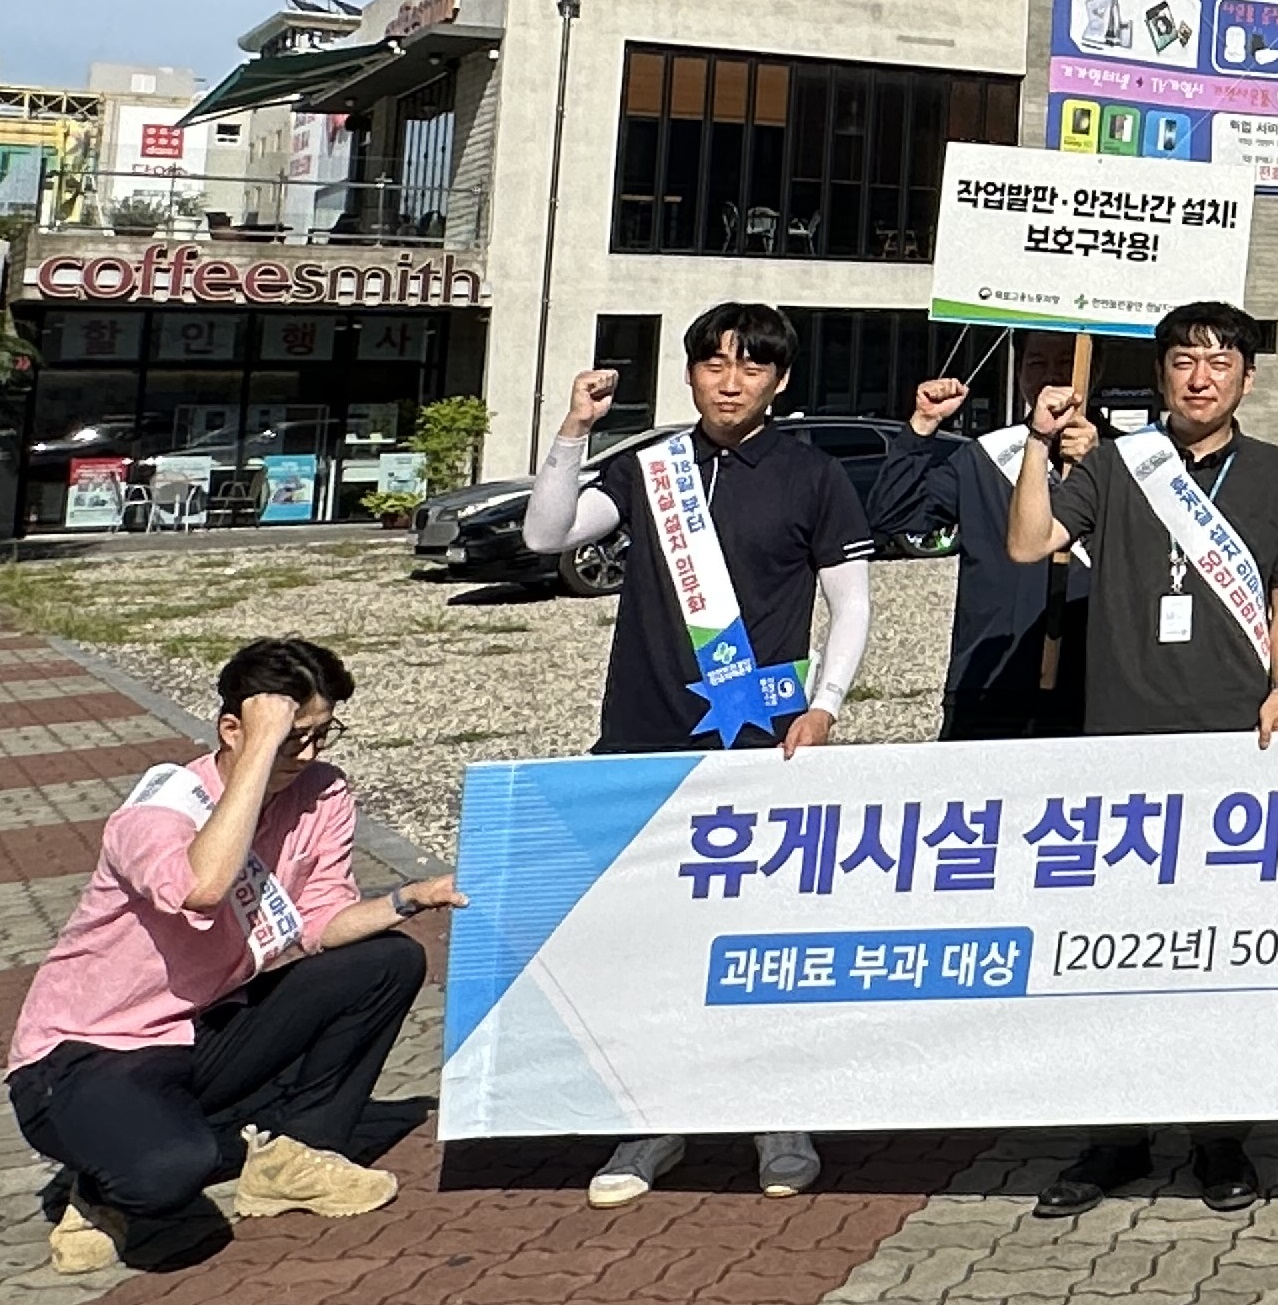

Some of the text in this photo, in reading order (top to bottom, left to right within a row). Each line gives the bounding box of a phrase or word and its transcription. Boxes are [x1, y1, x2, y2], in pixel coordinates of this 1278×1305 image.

[1182, 197, 1238, 229] 설치!
[1024, 224, 1160, 263] 보호구착용!
[37, 243, 483, 305] coffeesmith
[82, 320, 121, 355] 할
[181, 321, 215, 354] 인
[282, 321, 315, 356] 행
[377, 322, 412, 356] 사
[663, 514, 688, 553] 설치
[1210, 524, 1243, 562] 설치
[675, 555, 707, 615] 의무화
[679, 799, 1001, 898] 휴게시설
[1022, 793, 1184, 888] 설치
[719, 948, 837, 993] 과태료
[848, 945, 928, 989] 부과
[942, 942, 1020, 987] 대상
[1052, 926, 1216, 976] [2022년]
